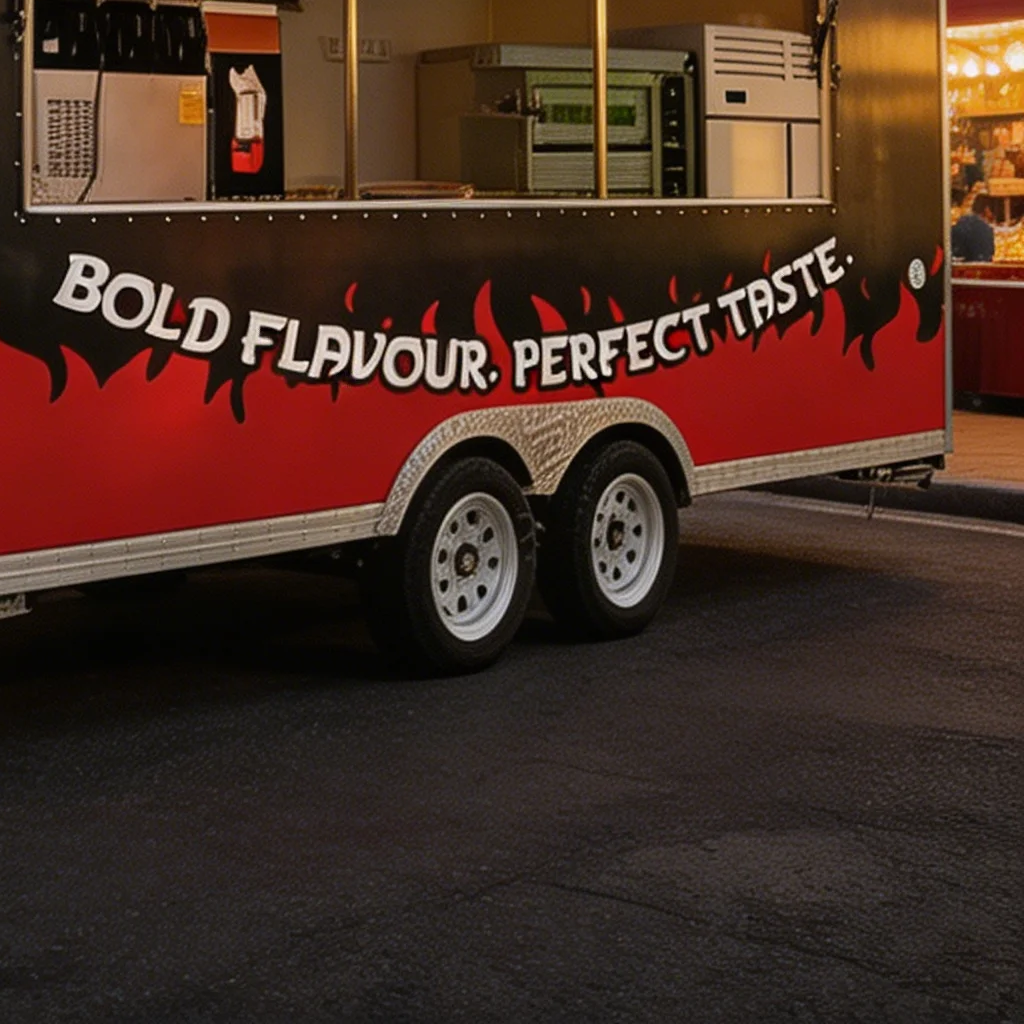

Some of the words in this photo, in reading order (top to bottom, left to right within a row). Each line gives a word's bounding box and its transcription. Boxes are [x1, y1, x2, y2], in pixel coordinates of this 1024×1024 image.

[53, 253, 231, 354] BOLD
[241, 310, 499, 390] FLAVOUR.
[513, 303, 711, 389] PERFECT
[716, 236, 854, 337] TASTE.
